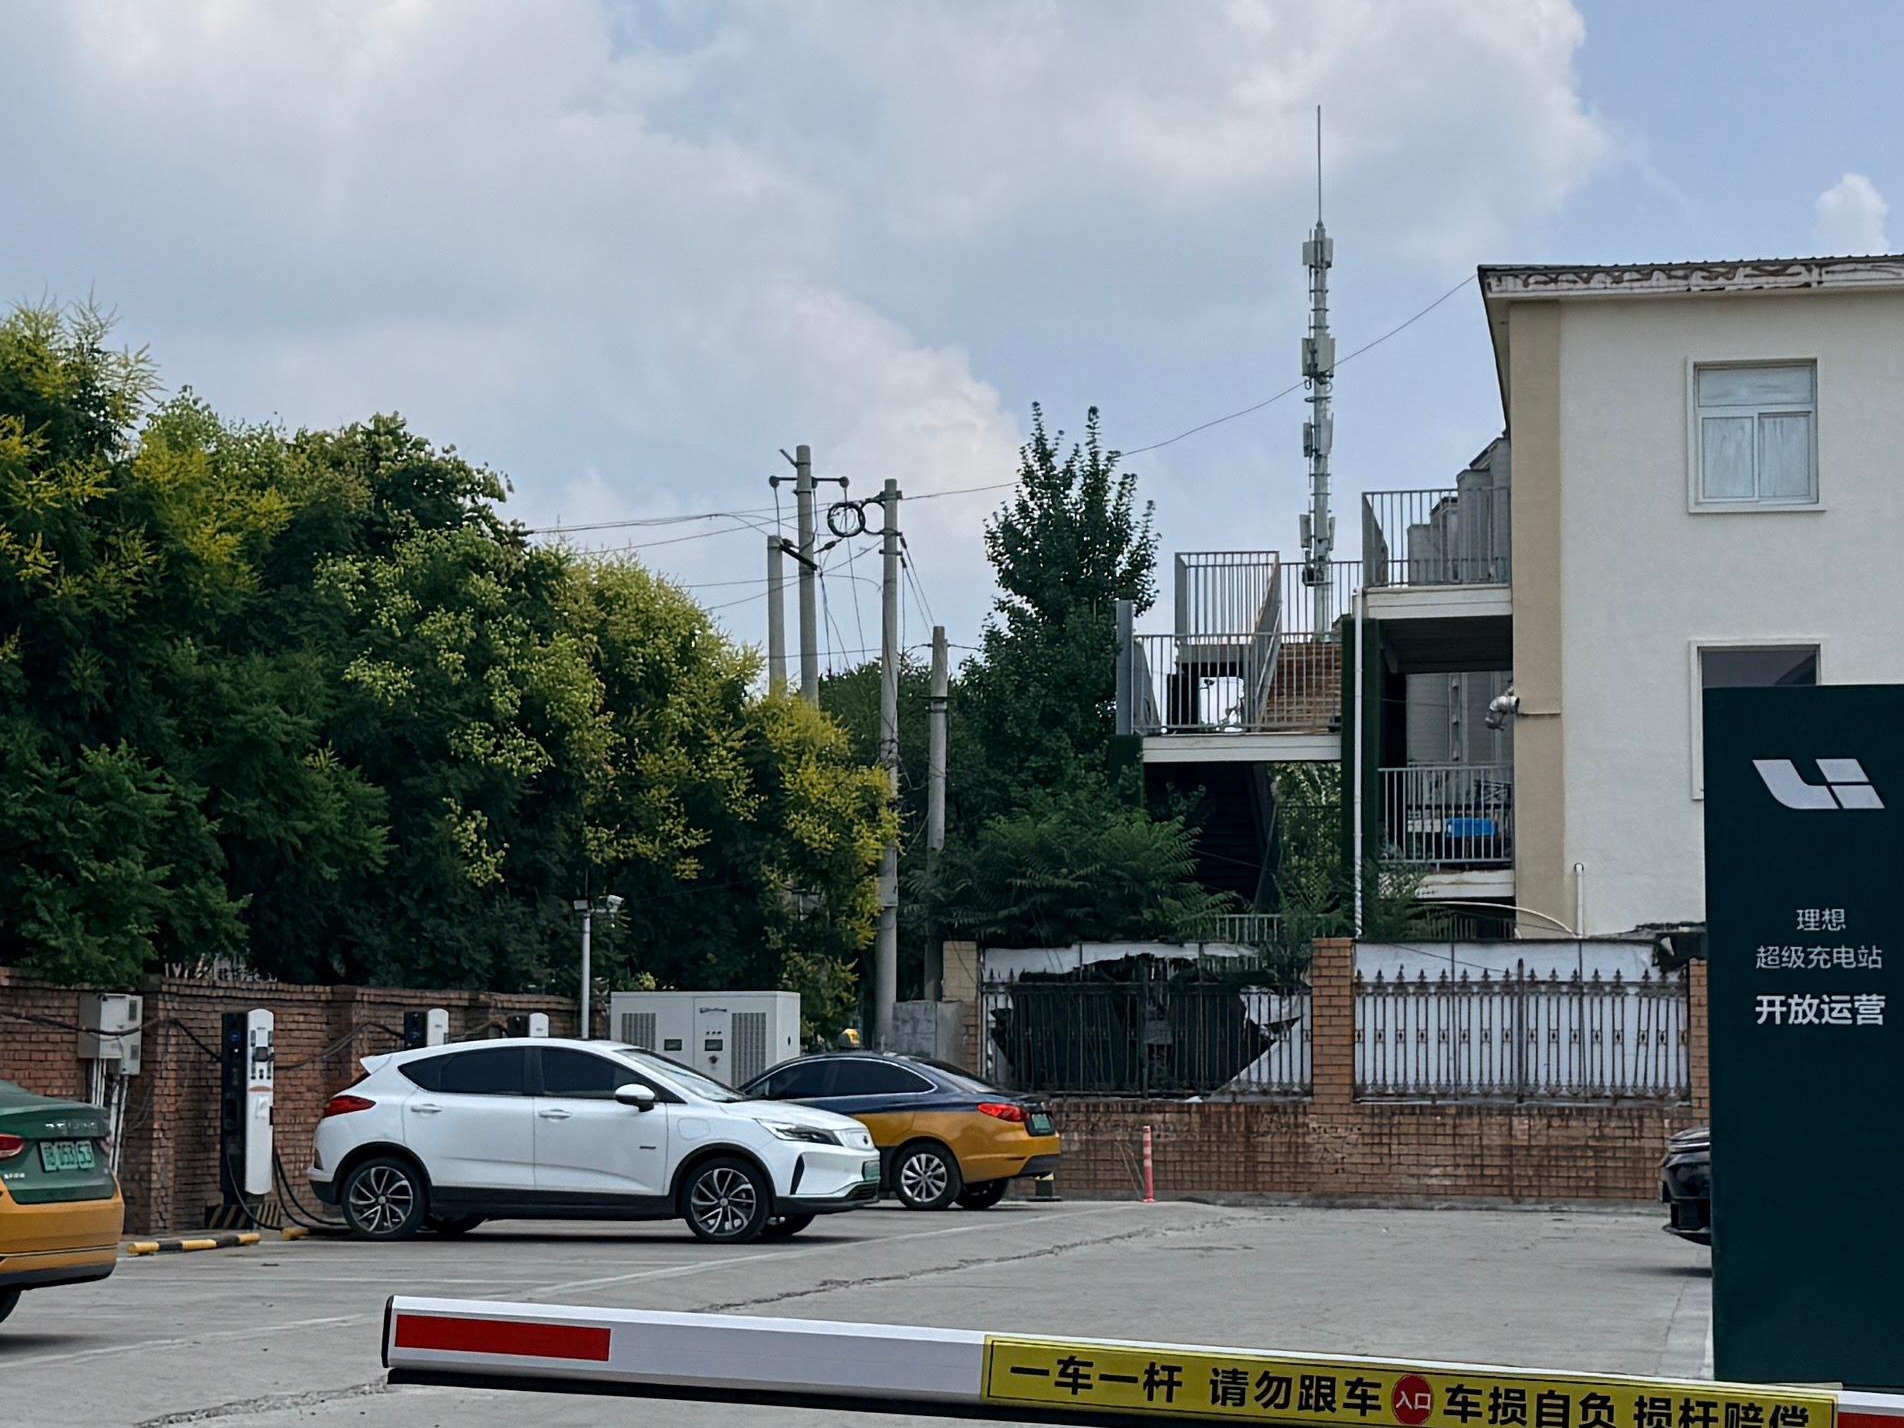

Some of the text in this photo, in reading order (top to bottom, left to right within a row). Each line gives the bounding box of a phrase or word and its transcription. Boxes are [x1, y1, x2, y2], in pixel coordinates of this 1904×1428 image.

[1795, 908, 1847, 932] 理想
[1755, 944, 1883, 970] 超级充电站
[1754, 993, 1886, 1026] 开放运营
[1010, 1355, 1183, 1404] 一车一杆
[1209, 1367, 1383, 1417] 请勿跟车
[1395, 1390, 1432, 1410] 入口
